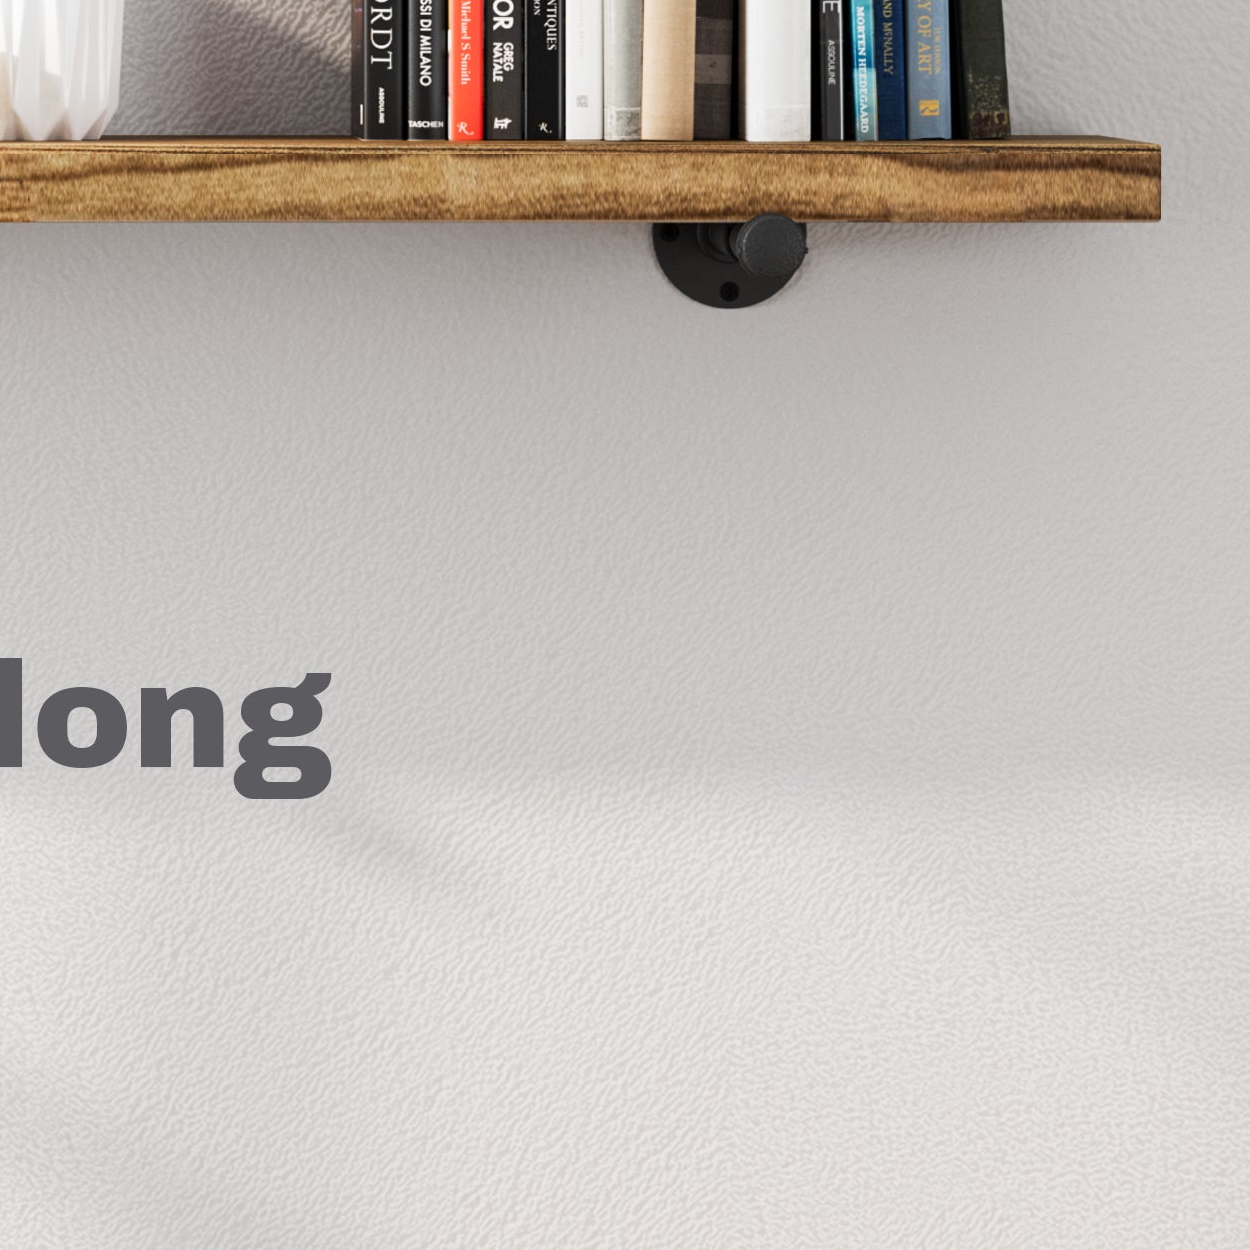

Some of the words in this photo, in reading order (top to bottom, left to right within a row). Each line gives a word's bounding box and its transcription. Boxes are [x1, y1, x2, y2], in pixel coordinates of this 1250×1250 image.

[420, 18, 433, 31] DI
[461, 1, 472, 40] Michael
[856, 6, 866, 55] MORTEN
[917, 16, 932, 38] OF
[420, 36, 433, 86] MILANO
[461, 42, 471, 51] S
[493, 42, 503, 82] NATALE
[503, 42, 513, 71] GREG
[827, 40, 836, 85] ASSOULINE
[917, 41, 932, 74] ART
[461, 53, 472, 84] Smith
[858, 59, 869, 133] HEEDEGAARD
